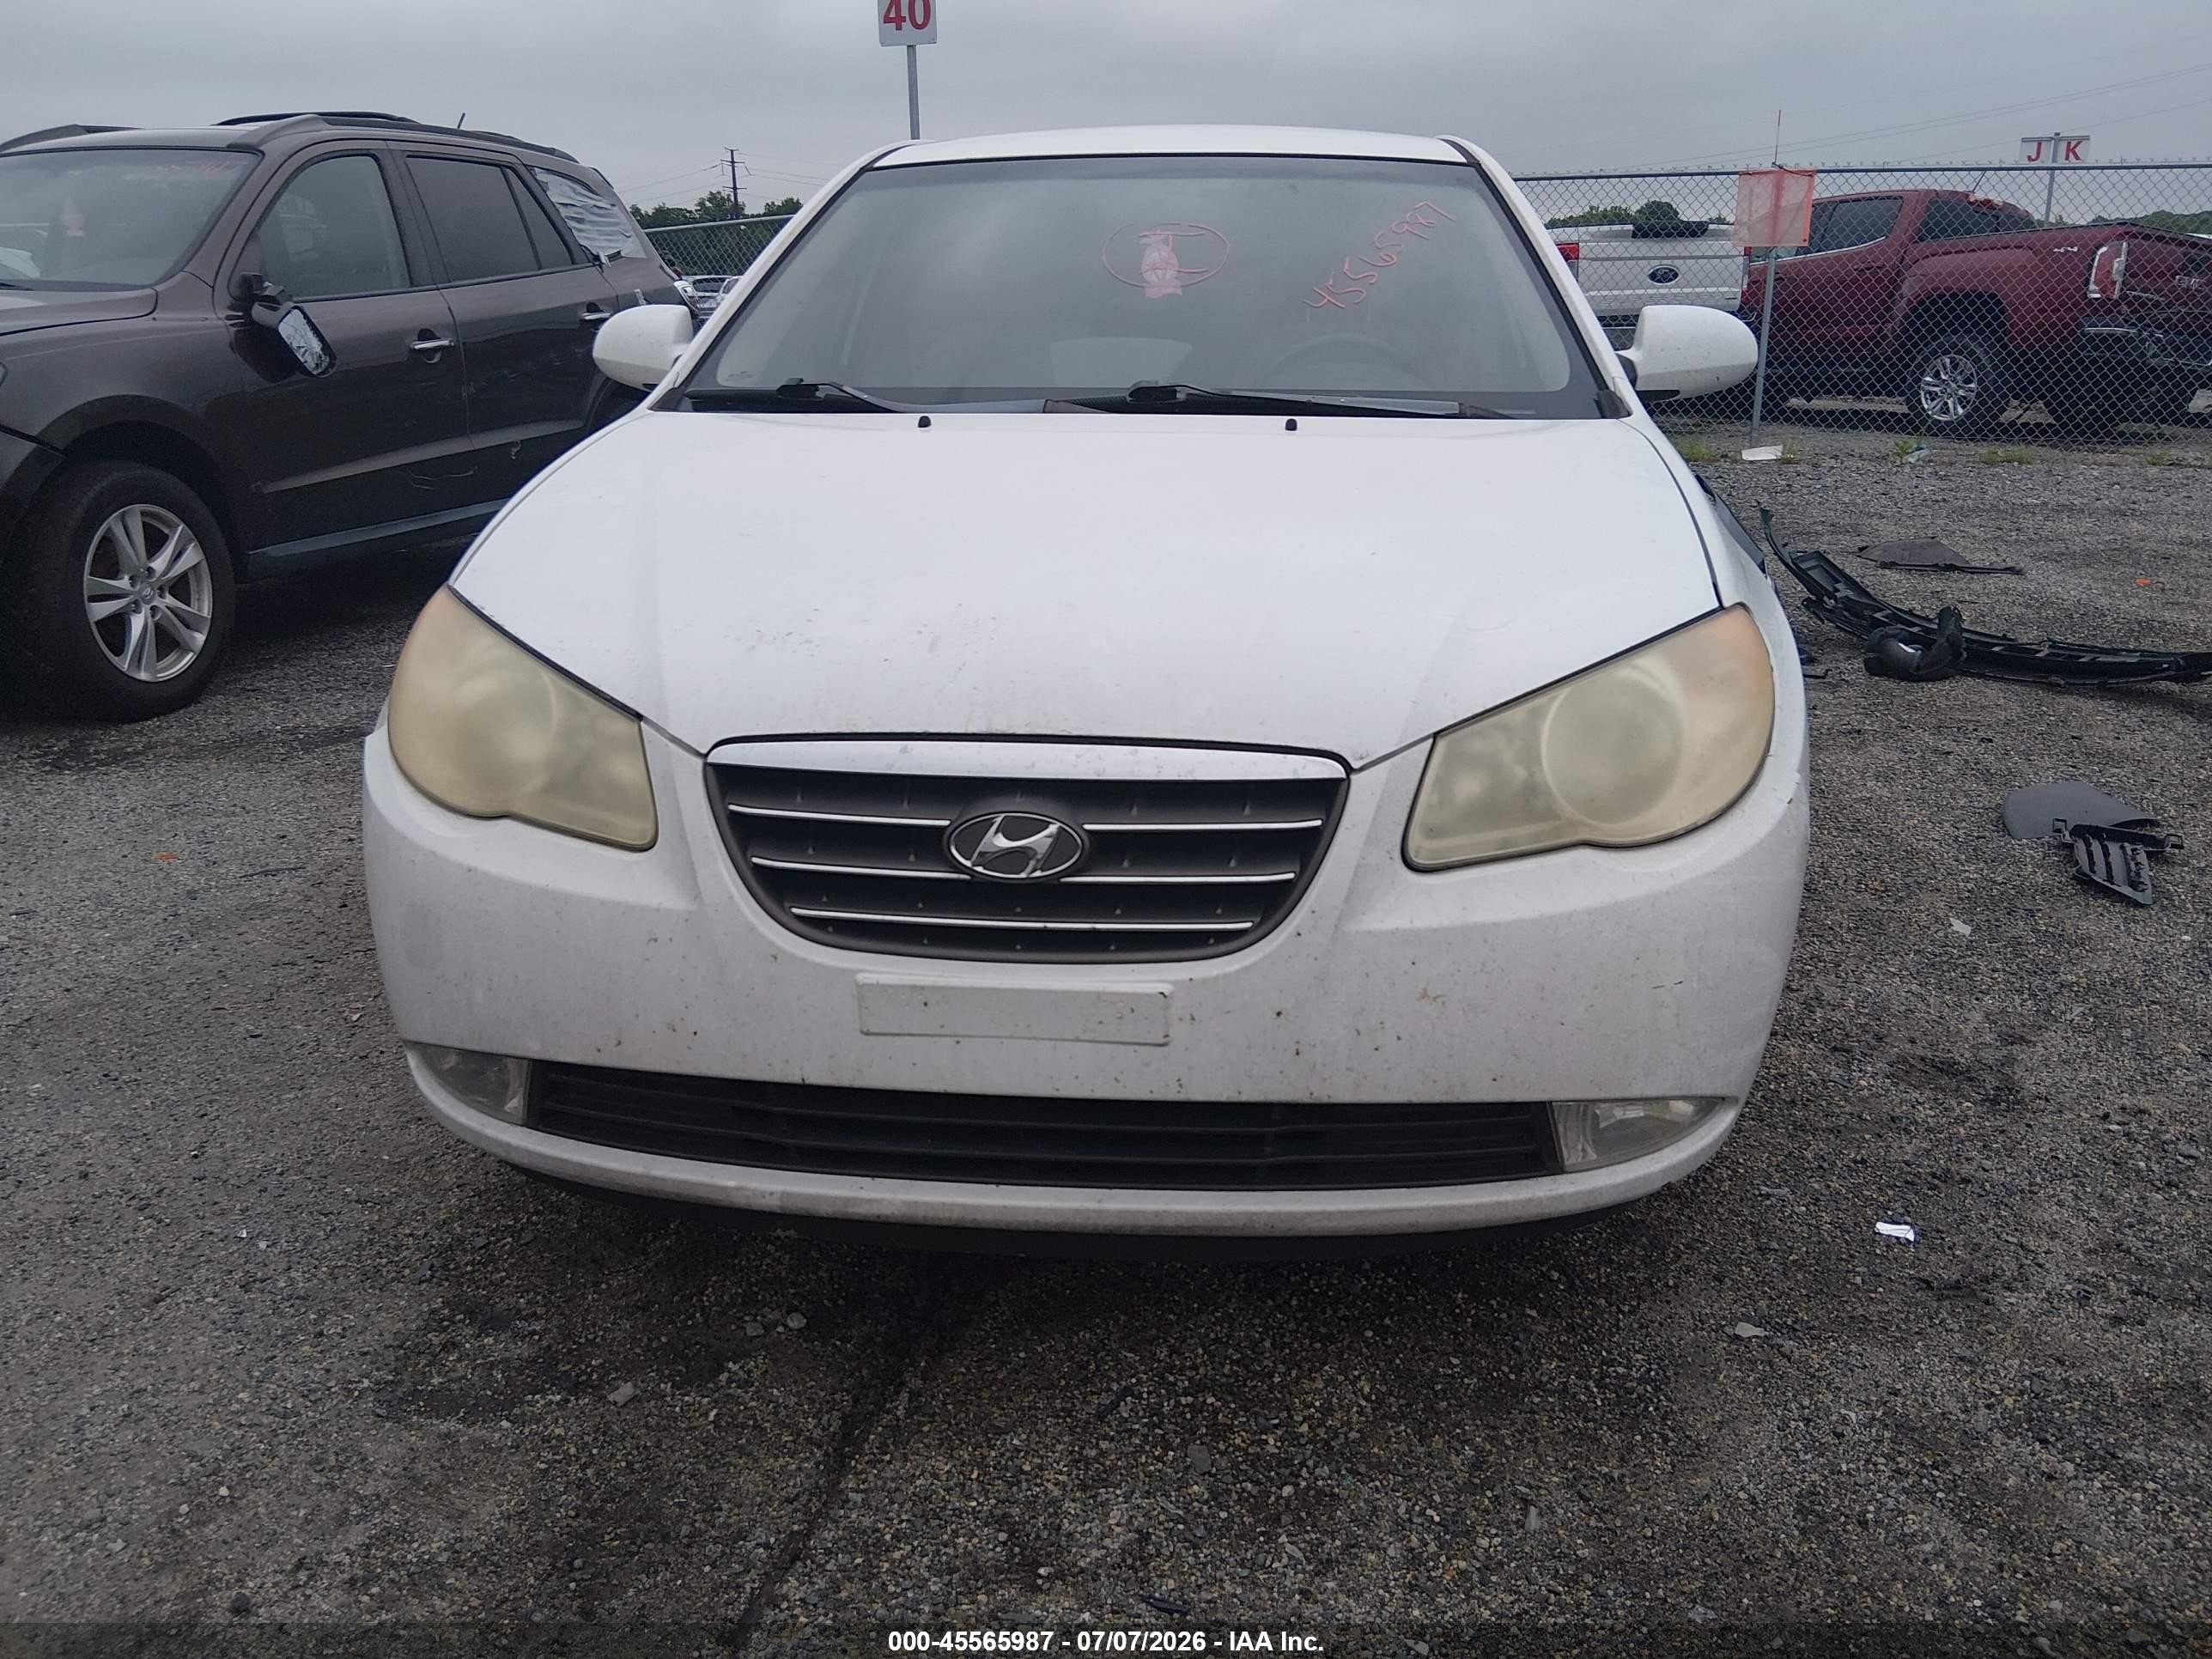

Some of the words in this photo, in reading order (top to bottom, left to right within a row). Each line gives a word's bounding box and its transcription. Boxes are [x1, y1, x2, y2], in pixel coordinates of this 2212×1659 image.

[883, 0, 932, 31] 40
[2027, 141, 2042, 162] J
[2064, 140, 2082, 161] K
[1301, 200, 1456, 310] 45565987
